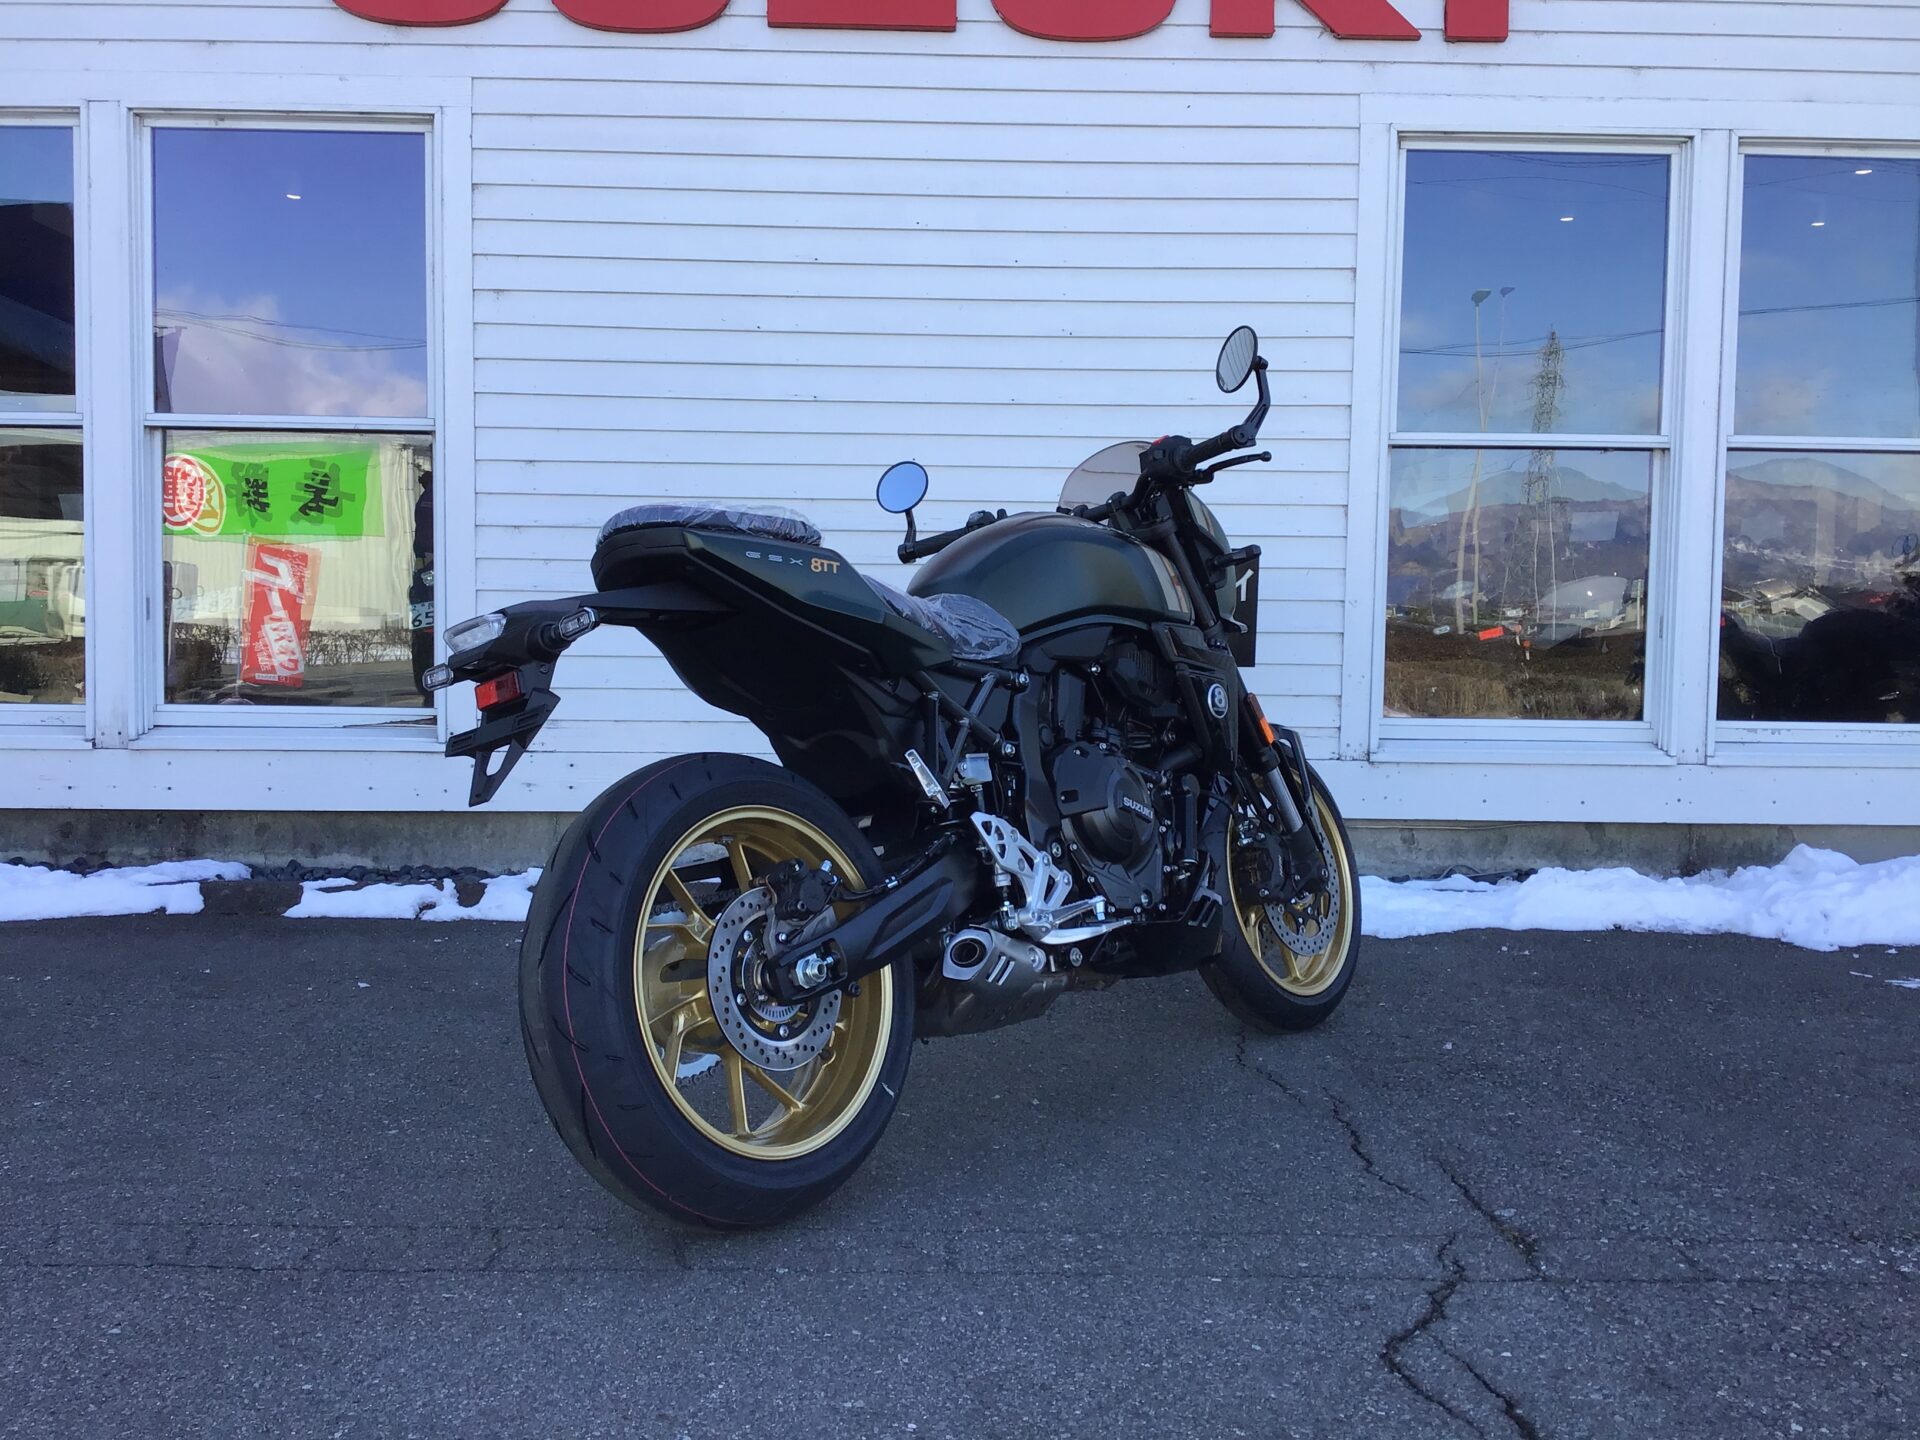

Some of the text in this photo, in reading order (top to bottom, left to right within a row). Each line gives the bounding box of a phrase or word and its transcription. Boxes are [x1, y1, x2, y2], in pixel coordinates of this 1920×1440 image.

[745, 550, 841, 575] GSX 8TT
[1214, 687, 1226, 708] 8
[1123, 796, 1153, 819] SUZUKI
